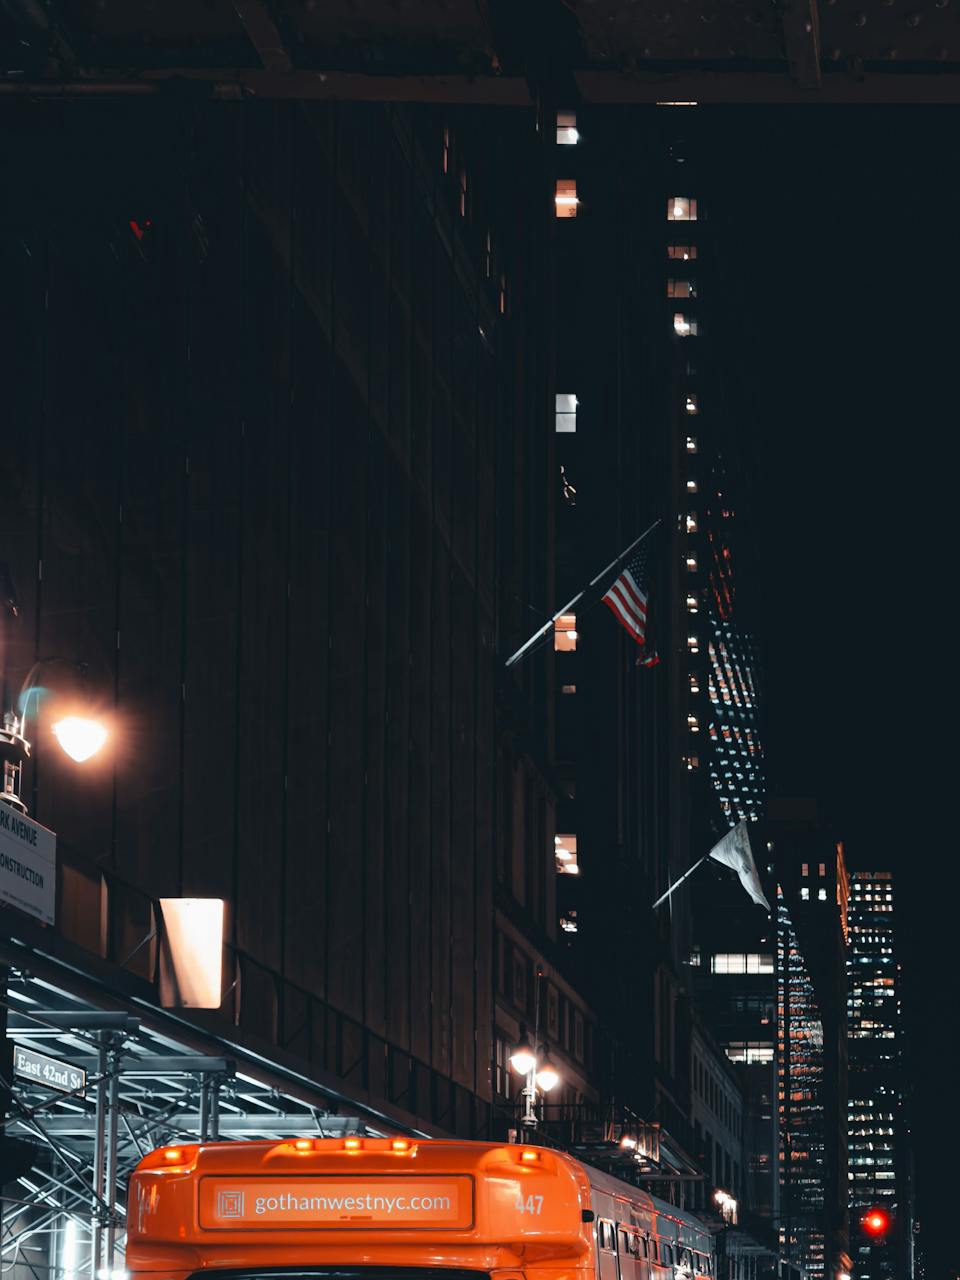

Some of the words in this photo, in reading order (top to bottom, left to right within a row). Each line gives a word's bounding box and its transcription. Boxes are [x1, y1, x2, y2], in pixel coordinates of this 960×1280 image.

[11, 816, 37, 847] AVENUE
[17, 1053, 41, 1077] East
[43, 1064, 68, 1086] 42nd
[70, 1072, 81, 1089] St
[255, 1193, 450, 1215] gothamwestnyc.com
[515, 1194, 544, 1216] 447
